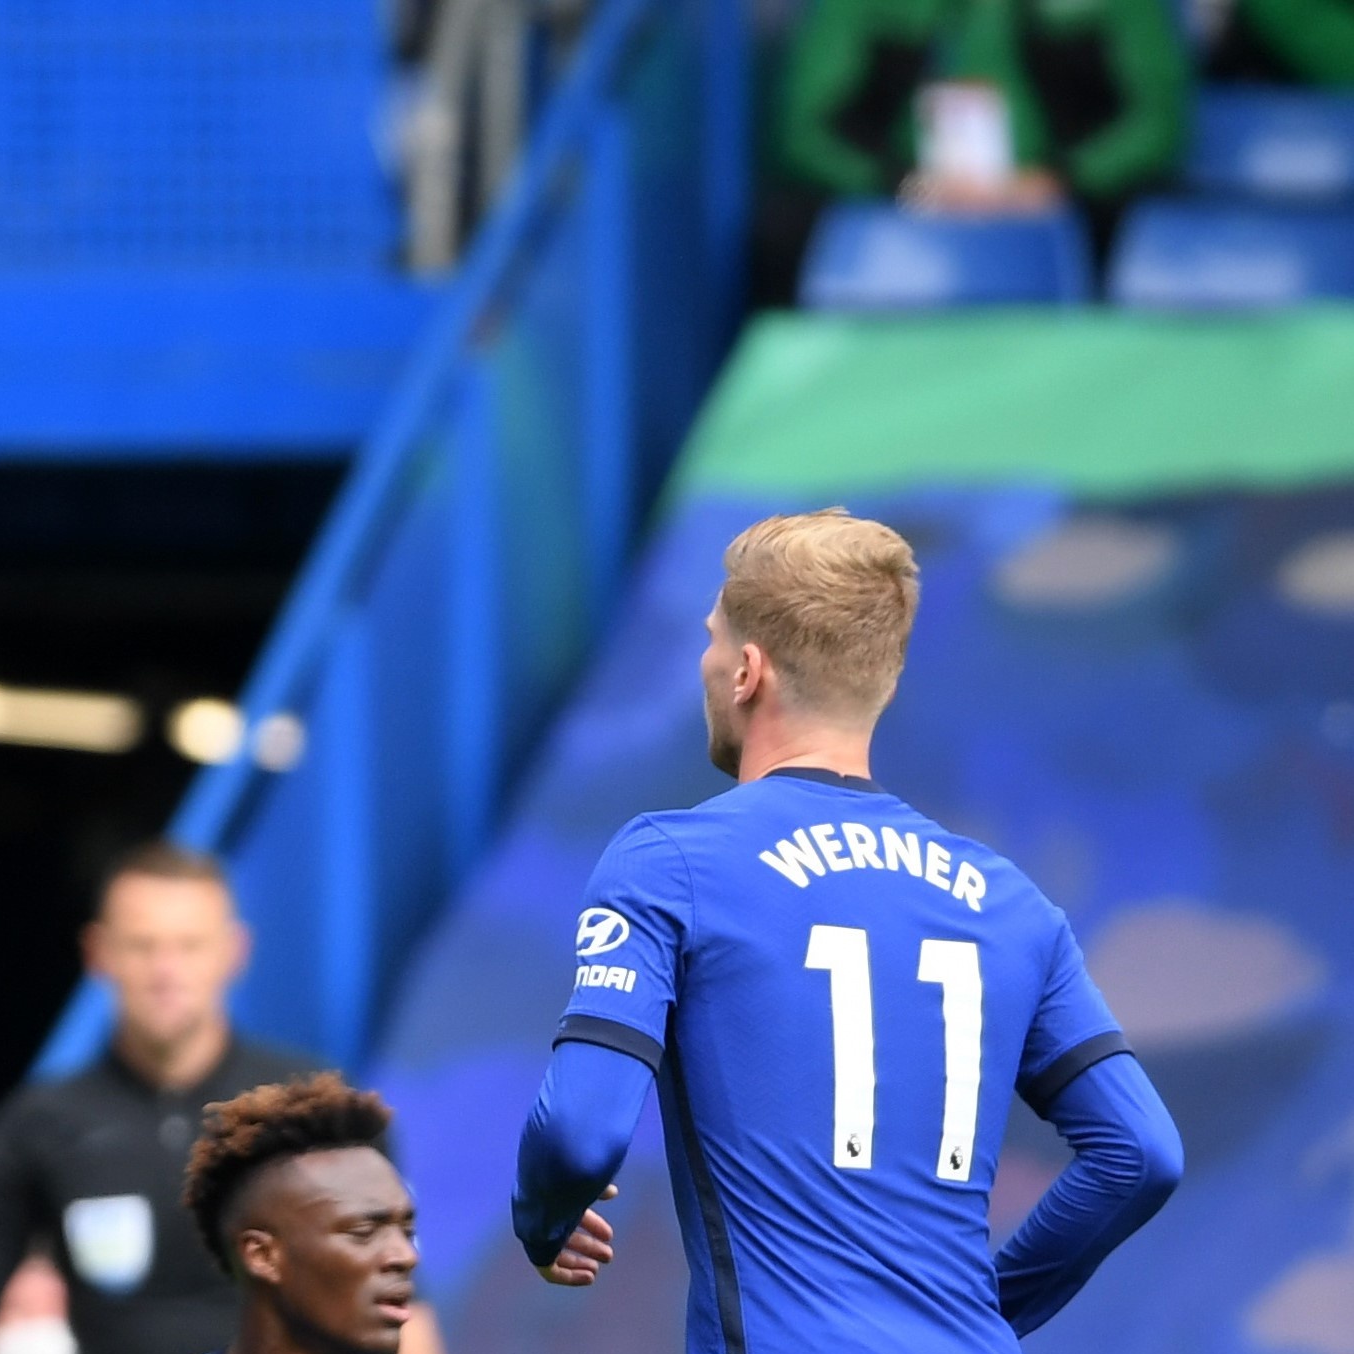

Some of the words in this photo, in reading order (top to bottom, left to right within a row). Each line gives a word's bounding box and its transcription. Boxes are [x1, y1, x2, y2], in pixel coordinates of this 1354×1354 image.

[758, 822, 988, 913] WERNER
[576, 964, 637, 993] NDAI
[804, 923, 984, 1182] 11
